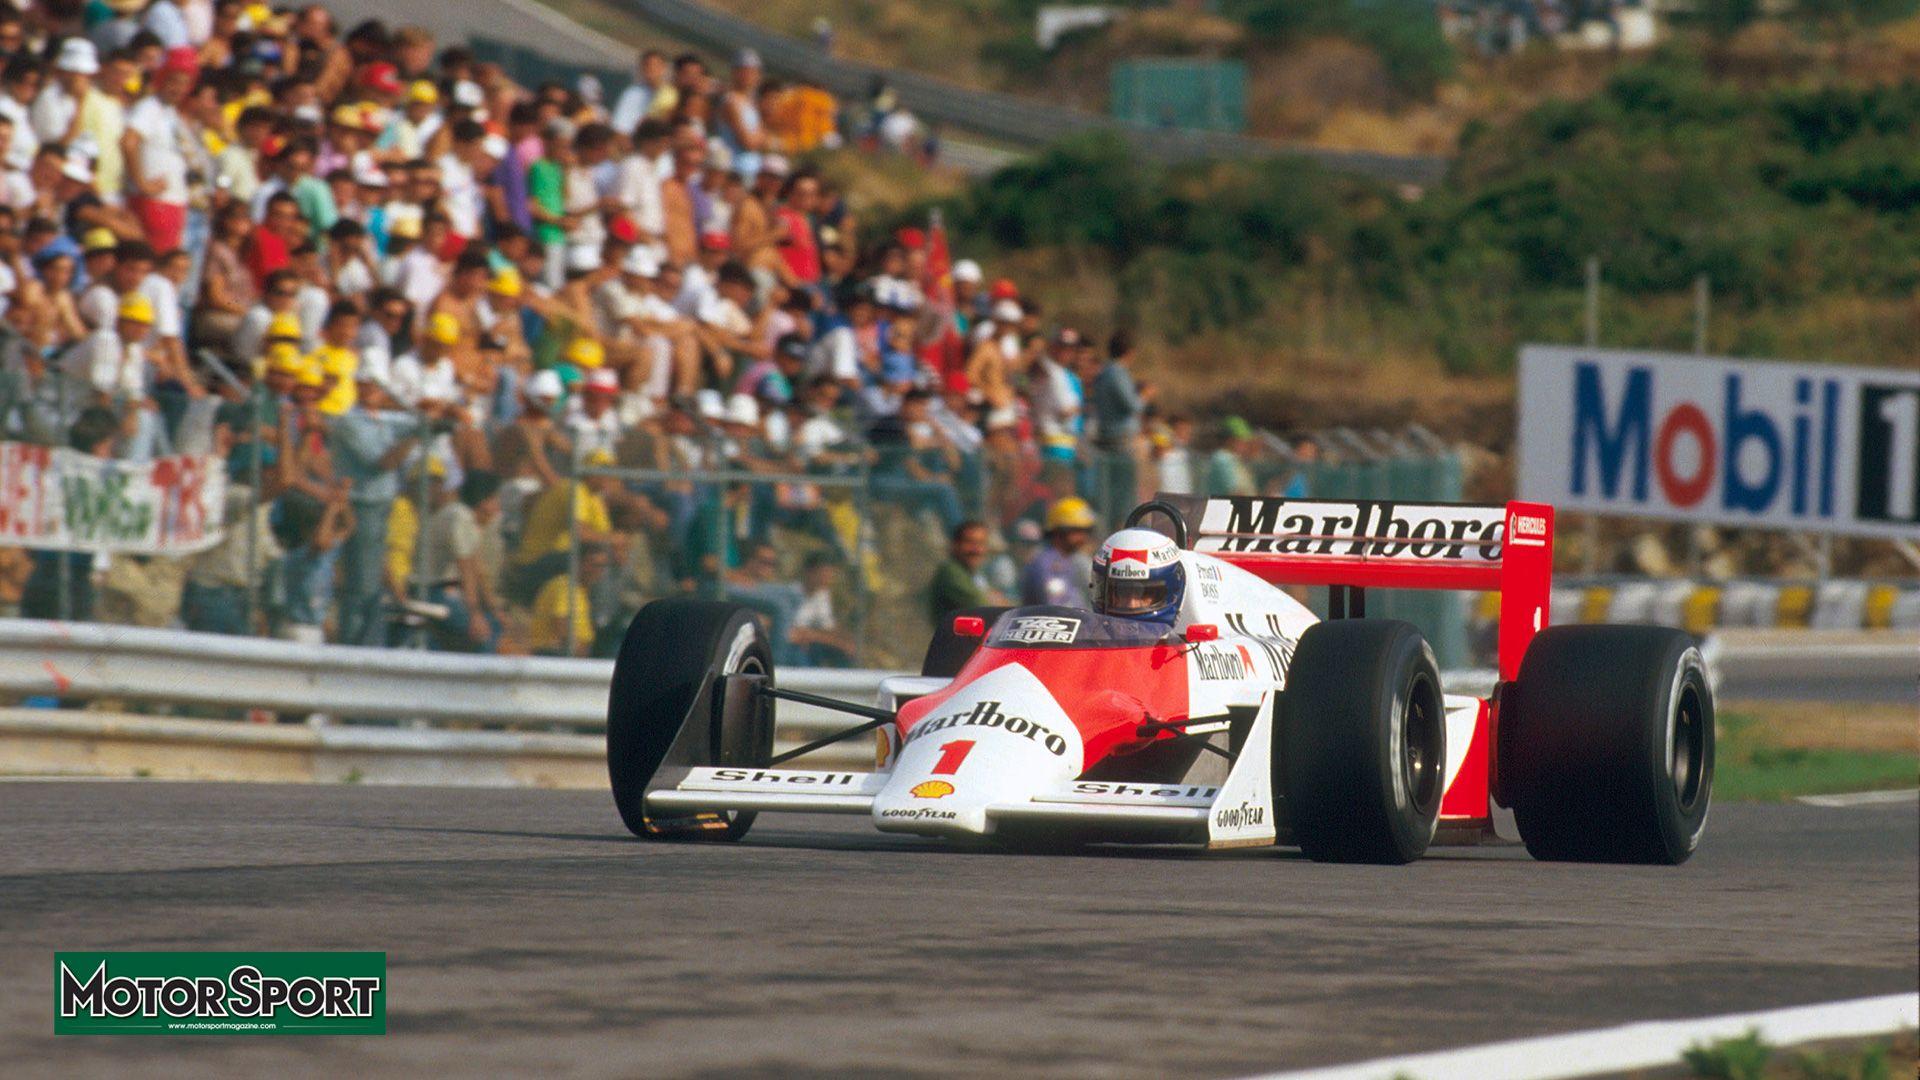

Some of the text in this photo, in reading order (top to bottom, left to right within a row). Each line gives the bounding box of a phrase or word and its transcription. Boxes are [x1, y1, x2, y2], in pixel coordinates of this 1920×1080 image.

[1571, 361, 1918, 521] Mobil 1
[1218, 499, 1505, 559] Marlboro
[1517, 515, 1546, 535] HERCULES
[1111, 564, 1146, 577] Marlboro
[1201, 582, 1219, 599] BOSS
[1013, 619, 1069, 632] TAG
[1001, 630, 1073, 641] HEUER
[1192, 644, 1245, 681] Marlboro
[905, 701, 1067, 757] Marlboro
[931, 740, 977, 775] 1
[711, 769, 853, 785] Shell
[1073, 783, 1216, 798] Shell
